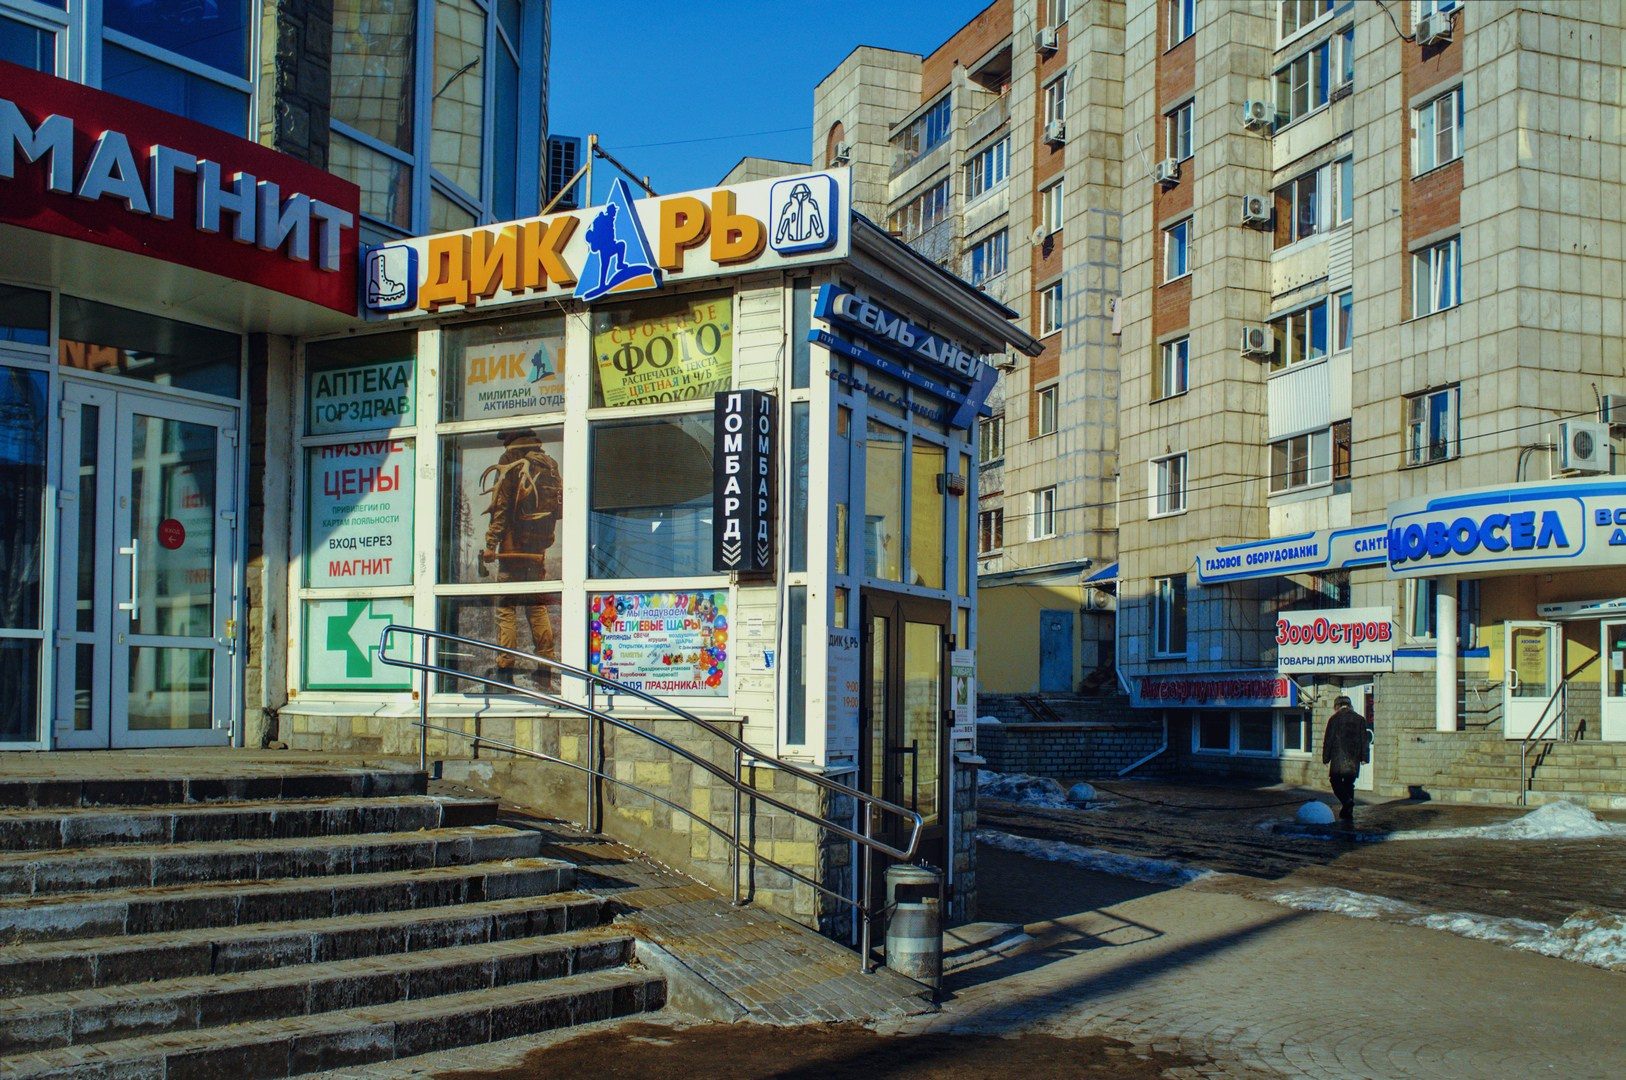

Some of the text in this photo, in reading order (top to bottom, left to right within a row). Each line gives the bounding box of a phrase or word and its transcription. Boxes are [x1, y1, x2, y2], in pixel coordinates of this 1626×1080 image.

[0, 98, 353, 272] МАГНИТ
[611, 304, 717, 344] СРОЧНОЕ
[612, 323, 722, 377] ФОТО
[622, 366, 683, 386] РАСПЕЧАТКА
[685, 356, 718, 372] ТЕКСТА
[820, 333, 834, 345] ПН
[851, 347, 861, 357] ВТ
[877, 358, 888, 368] СР
[902, 369, 912, 379] ЧТ
[924, 380, 934, 390] ПТ
[946, 390, 956, 399] СБ
[316, 365, 409, 398] АПТЕКА
[478, 388, 531, 402] МИЛИТАРИ
[629, 376, 679, 397] ЦВЕТНАЯ
[682, 375, 690, 384] И
[694, 369, 712, 381] Ч/Б
[316, 396, 410, 423] ГОРЗДРАВ
[483, 396, 537, 411] АКТИВНЫЙ
[723, 394, 743, 541] ЛОМБАРД
[757, 396, 769, 542] ЛОМБАРД
[324, 465, 399, 500] ЦЕНЫ
[332, 503, 391, 514] ПРИВИЛЕГИИ ПО
[329, 535, 392, 550] ВХОД ЧЕРЕЗ
[329, 558, 393, 577] МАГНИТ
[1206, 544, 1318, 571] ГАЗОВОЕ ОБОРУДОВАНИЕ
[615, 619, 701, 632] ГЕЛИЕВЫЕ ШАРЫ
[1275, 617, 1392, 650] ЗооОстров
[1278, 654, 1392, 667] ТОВАРЫ ДЛЯ ЖИВОТНЫХ
[645, 680, 707, 690] ПРАЗДНИКА!!!
